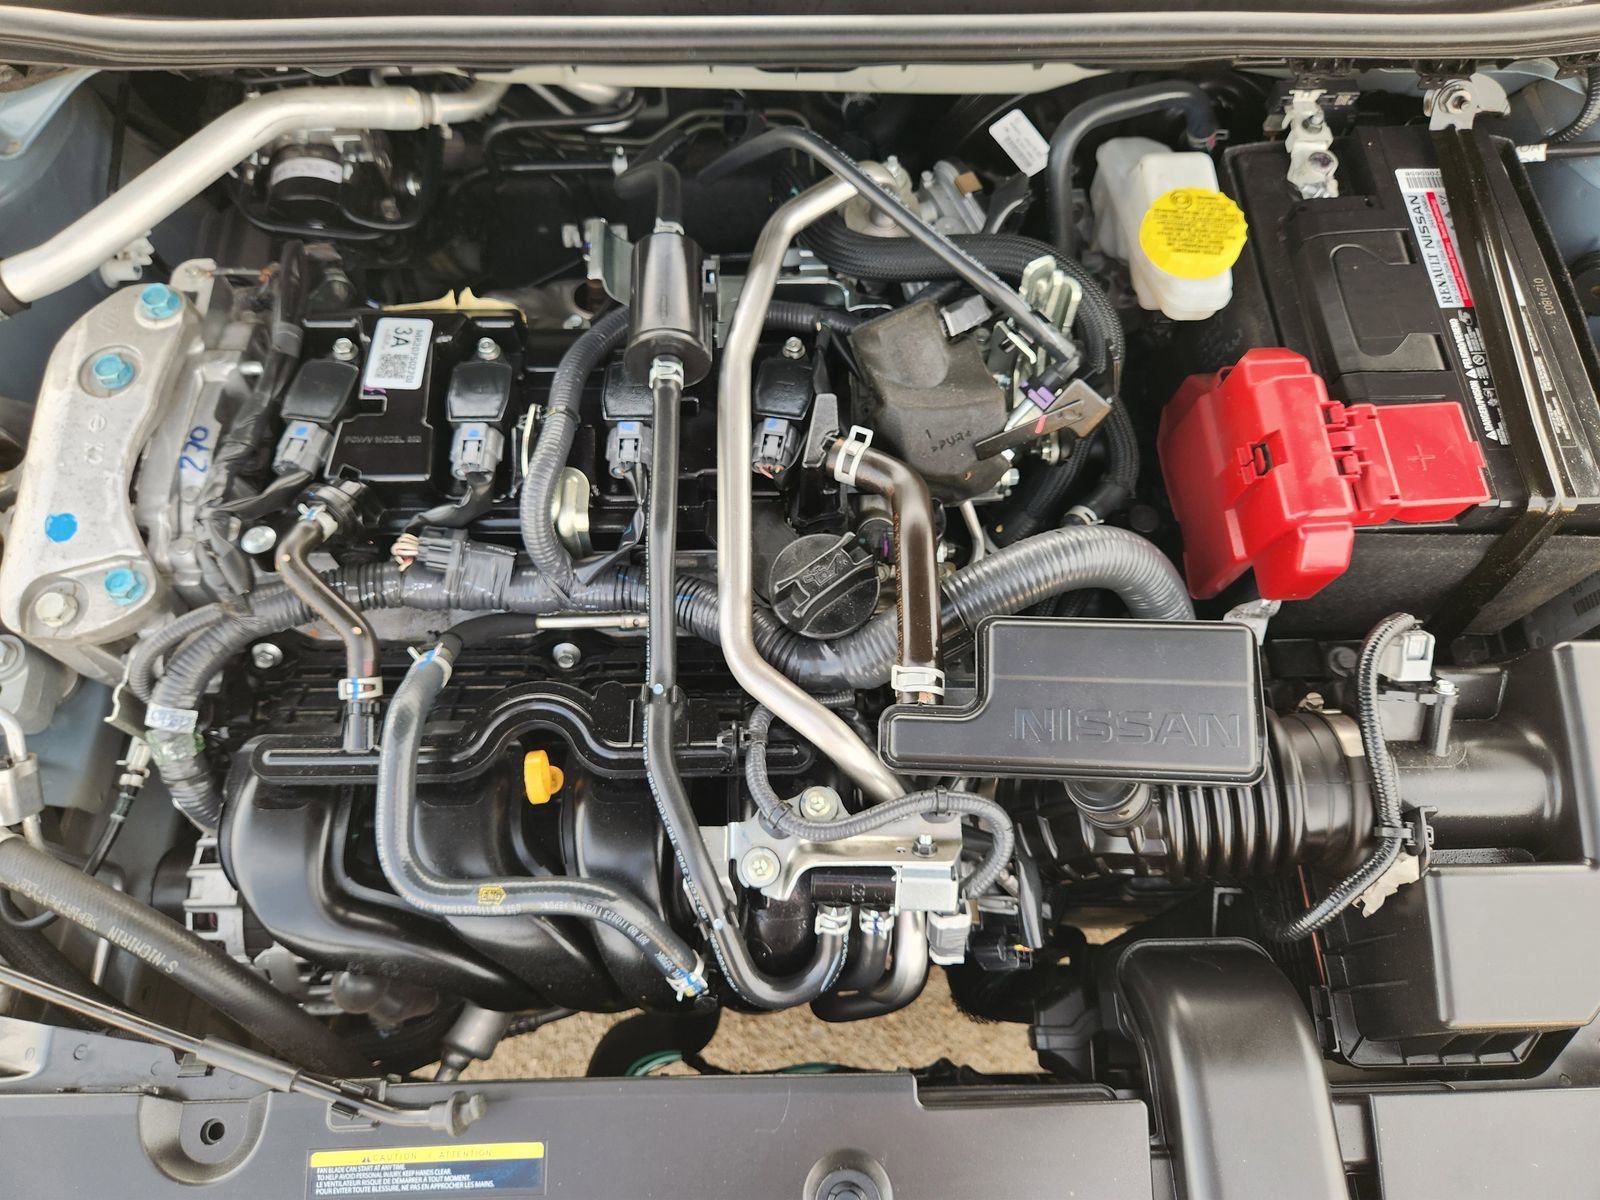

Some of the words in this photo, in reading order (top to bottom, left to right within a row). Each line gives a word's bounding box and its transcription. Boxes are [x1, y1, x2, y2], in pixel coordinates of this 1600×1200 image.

[1408, 195, 1436, 249] NISSAN
[1427, 252, 1454, 304] RENAULT
[390, 327, 414, 348] 3A
[1470, 380, 1494, 431] DANGER/POISON
[1014, 709, 1240, 748] NISSAN
[373, 1152, 417, 1163] CAUTION
[439, 1149, 492, 1159] ATTENTION
[316, 1166, 328, 1174] FAN
[346, 1165, 357, 1173] CAN
[358, 1164, 373, 1172] START
[381, 1163, 392, 1171] ANY
[317, 1173, 325, 1181] TO
[325, 1173, 338, 1181] HELP
[338, 1172, 355, 1180] AVOID
[355, 1171, 383, 1179] PERSONAL
[402, 1169, 415, 1177] KEEP
[416, 1168, 433, 1176] HANDS
[316, 1180, 323, 1188] LE
[323, 1178, 361, 1188] VENTILATEUR
[361, 1177, 382, 1186] RISQUE
[383, 1177, 390, 1185] DE
[428, 1174, 444, 1182] TOUT
[316, 1186, 332, 1195] POUR
[352, 1185, 371, 1193] TOUTE
[401, 1183, 410, 1191] NE
[410, 1183, 421, 1191] PAS
[421, 1182, 430, 1190] EN
[430, 1181, 464, 1190] APPROCHER
